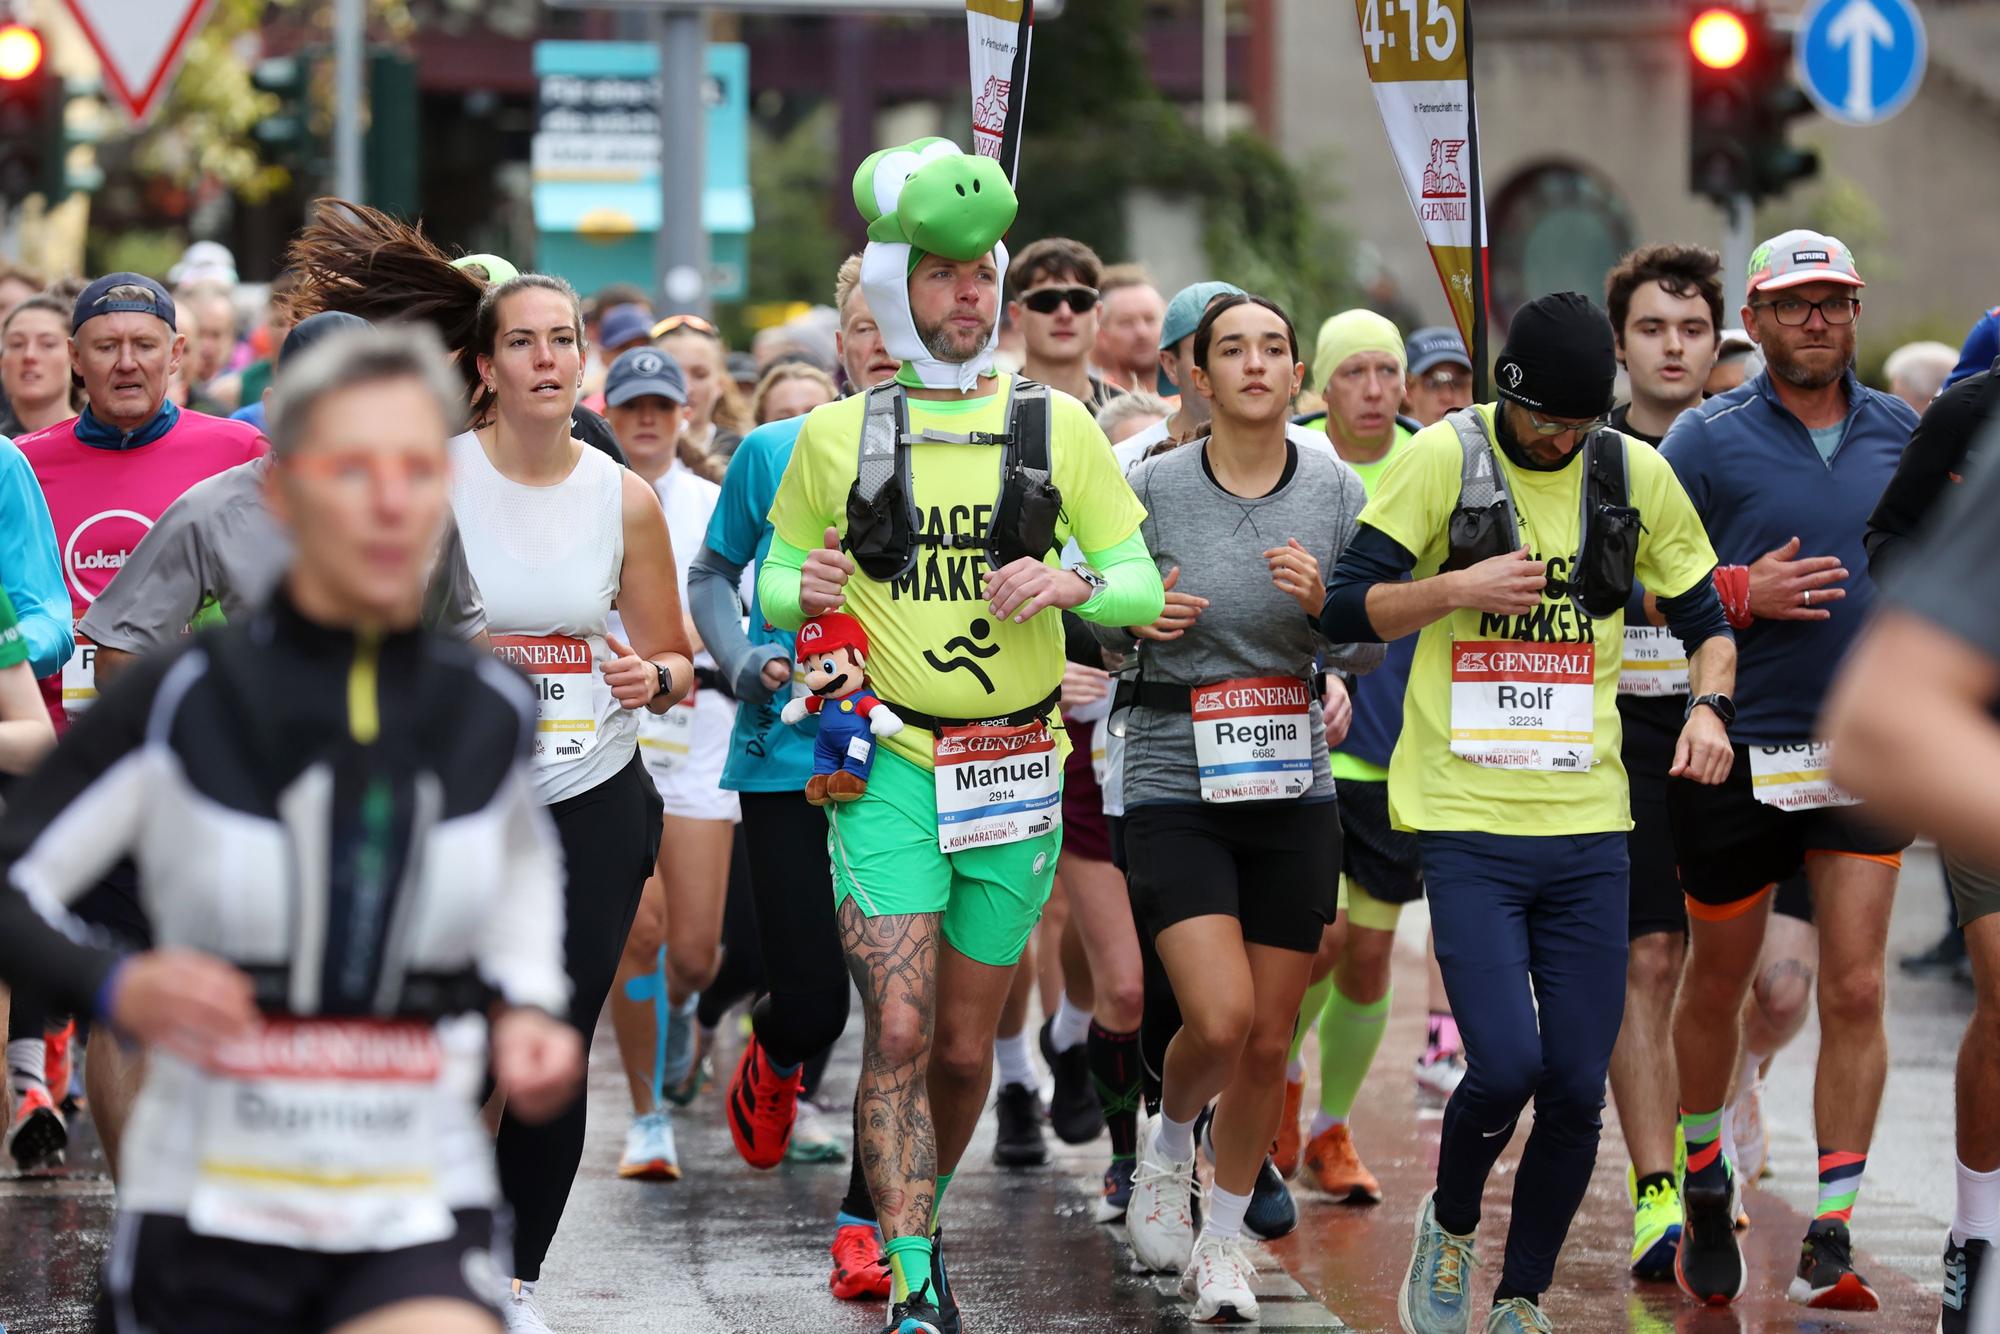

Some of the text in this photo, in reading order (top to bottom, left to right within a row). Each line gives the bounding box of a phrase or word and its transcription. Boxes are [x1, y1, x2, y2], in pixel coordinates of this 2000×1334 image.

[1362, 0, 1457, 64] 4:15
[74, 549, 131, 570] Lokal
[890, 555, 987, 602] MAKE
[1479, 603, 1595, 644] MAKER
[493, 645, 588, 664] GENERALI
[1489, 652, 1591, 675] GENERALI
[1225, 686, 1307, 709] GENERALI
[1497, 685, 1554, 710] Rolf
[1508, 715, 1544, 728] 32234
[1215, 719, 1298, 747] Regina
[556, 746, 581, 756] PUMA
[1252, 747, 1276, 759] 6682
[1484, 754, 1530, 766] MARATHON
[1552, 757, 1577, 767] PUMA
[955, 755, 1050, 791] Manuel
[988, 789, 1015, 803] 2914
[1231, 786, 1270, 797] MARATHON
[1285, 785, 1301, 794] PUMA
[1786, 793, 1828, 806] MARATHON
[967, 828, 1007, 844] MARATHON
[1028, 822, 1050, 835] PUMA
